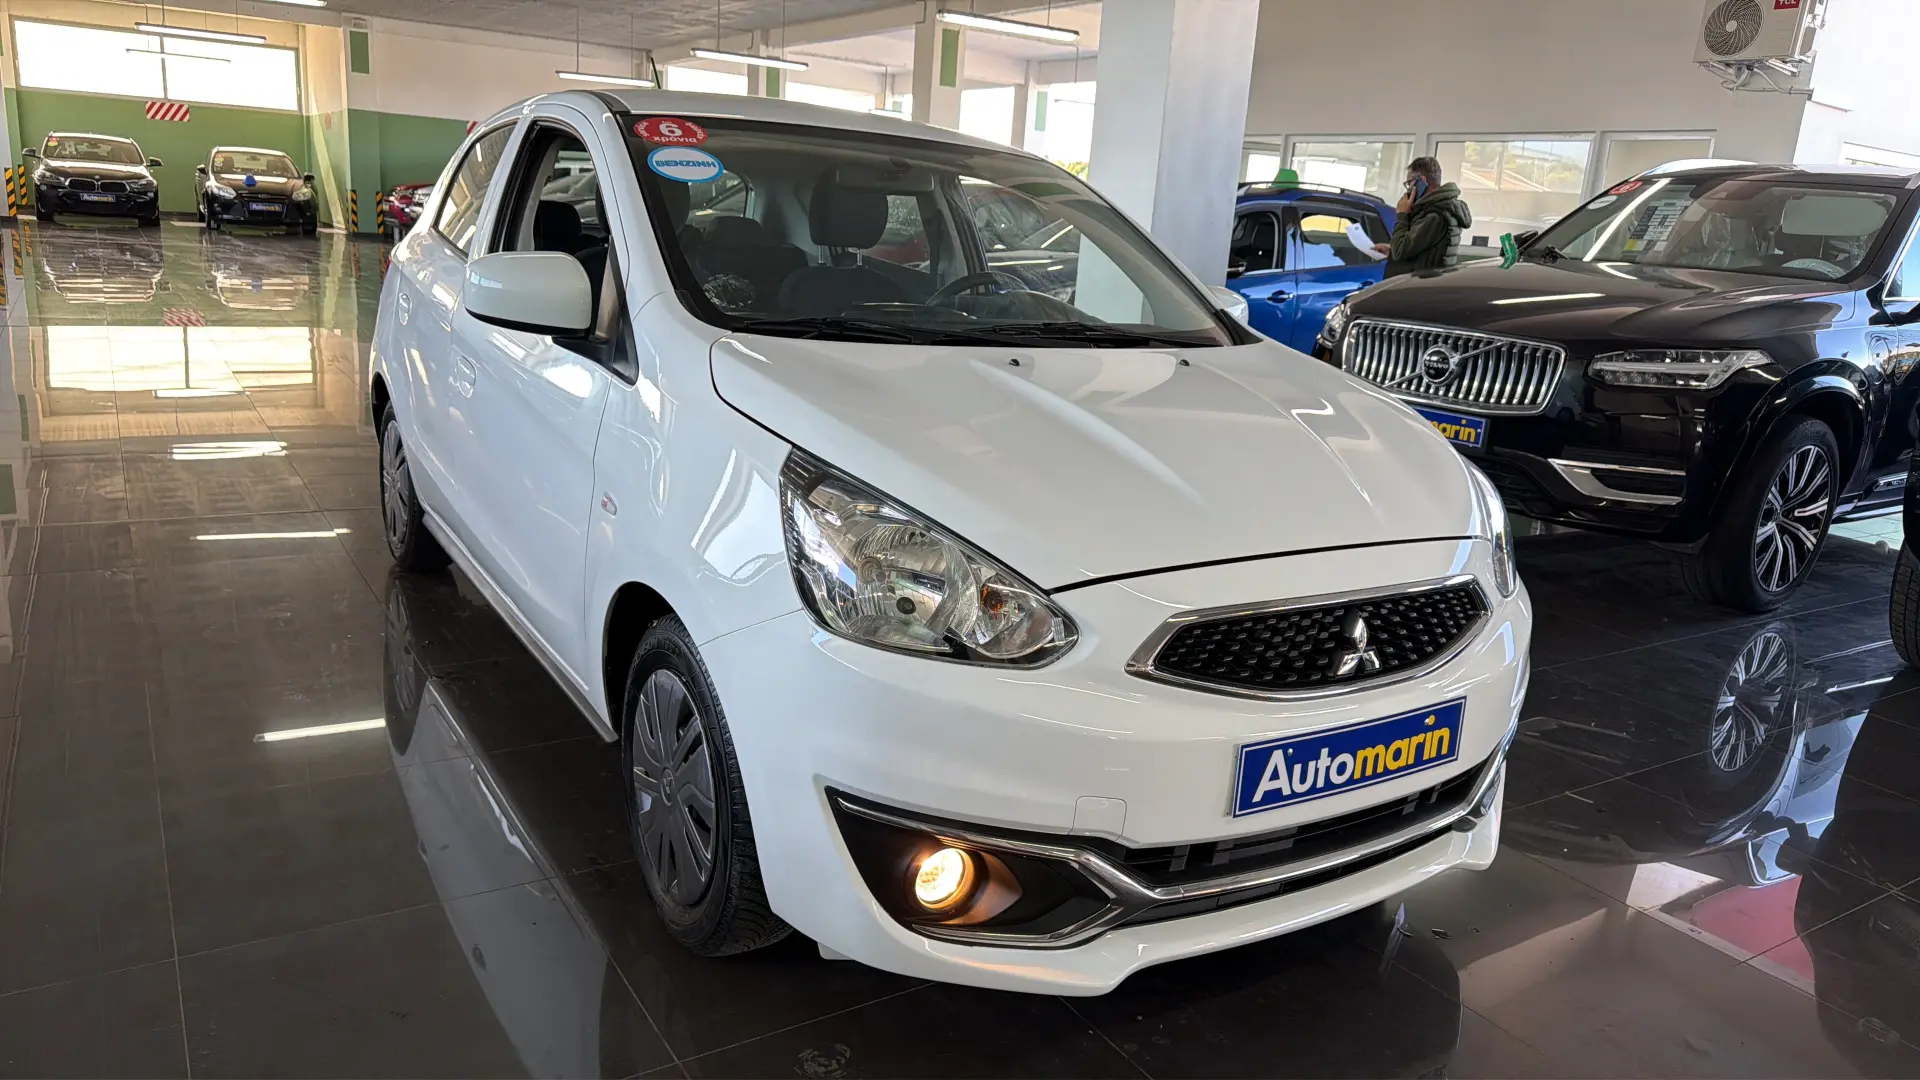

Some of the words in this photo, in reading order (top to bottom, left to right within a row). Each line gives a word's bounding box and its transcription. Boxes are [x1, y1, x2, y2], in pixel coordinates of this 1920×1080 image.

[659, 123, 683, 136] 6
[1425, 361, 1448, 369] VOLVO
[1252, 714, 1450, 803] Automarin
